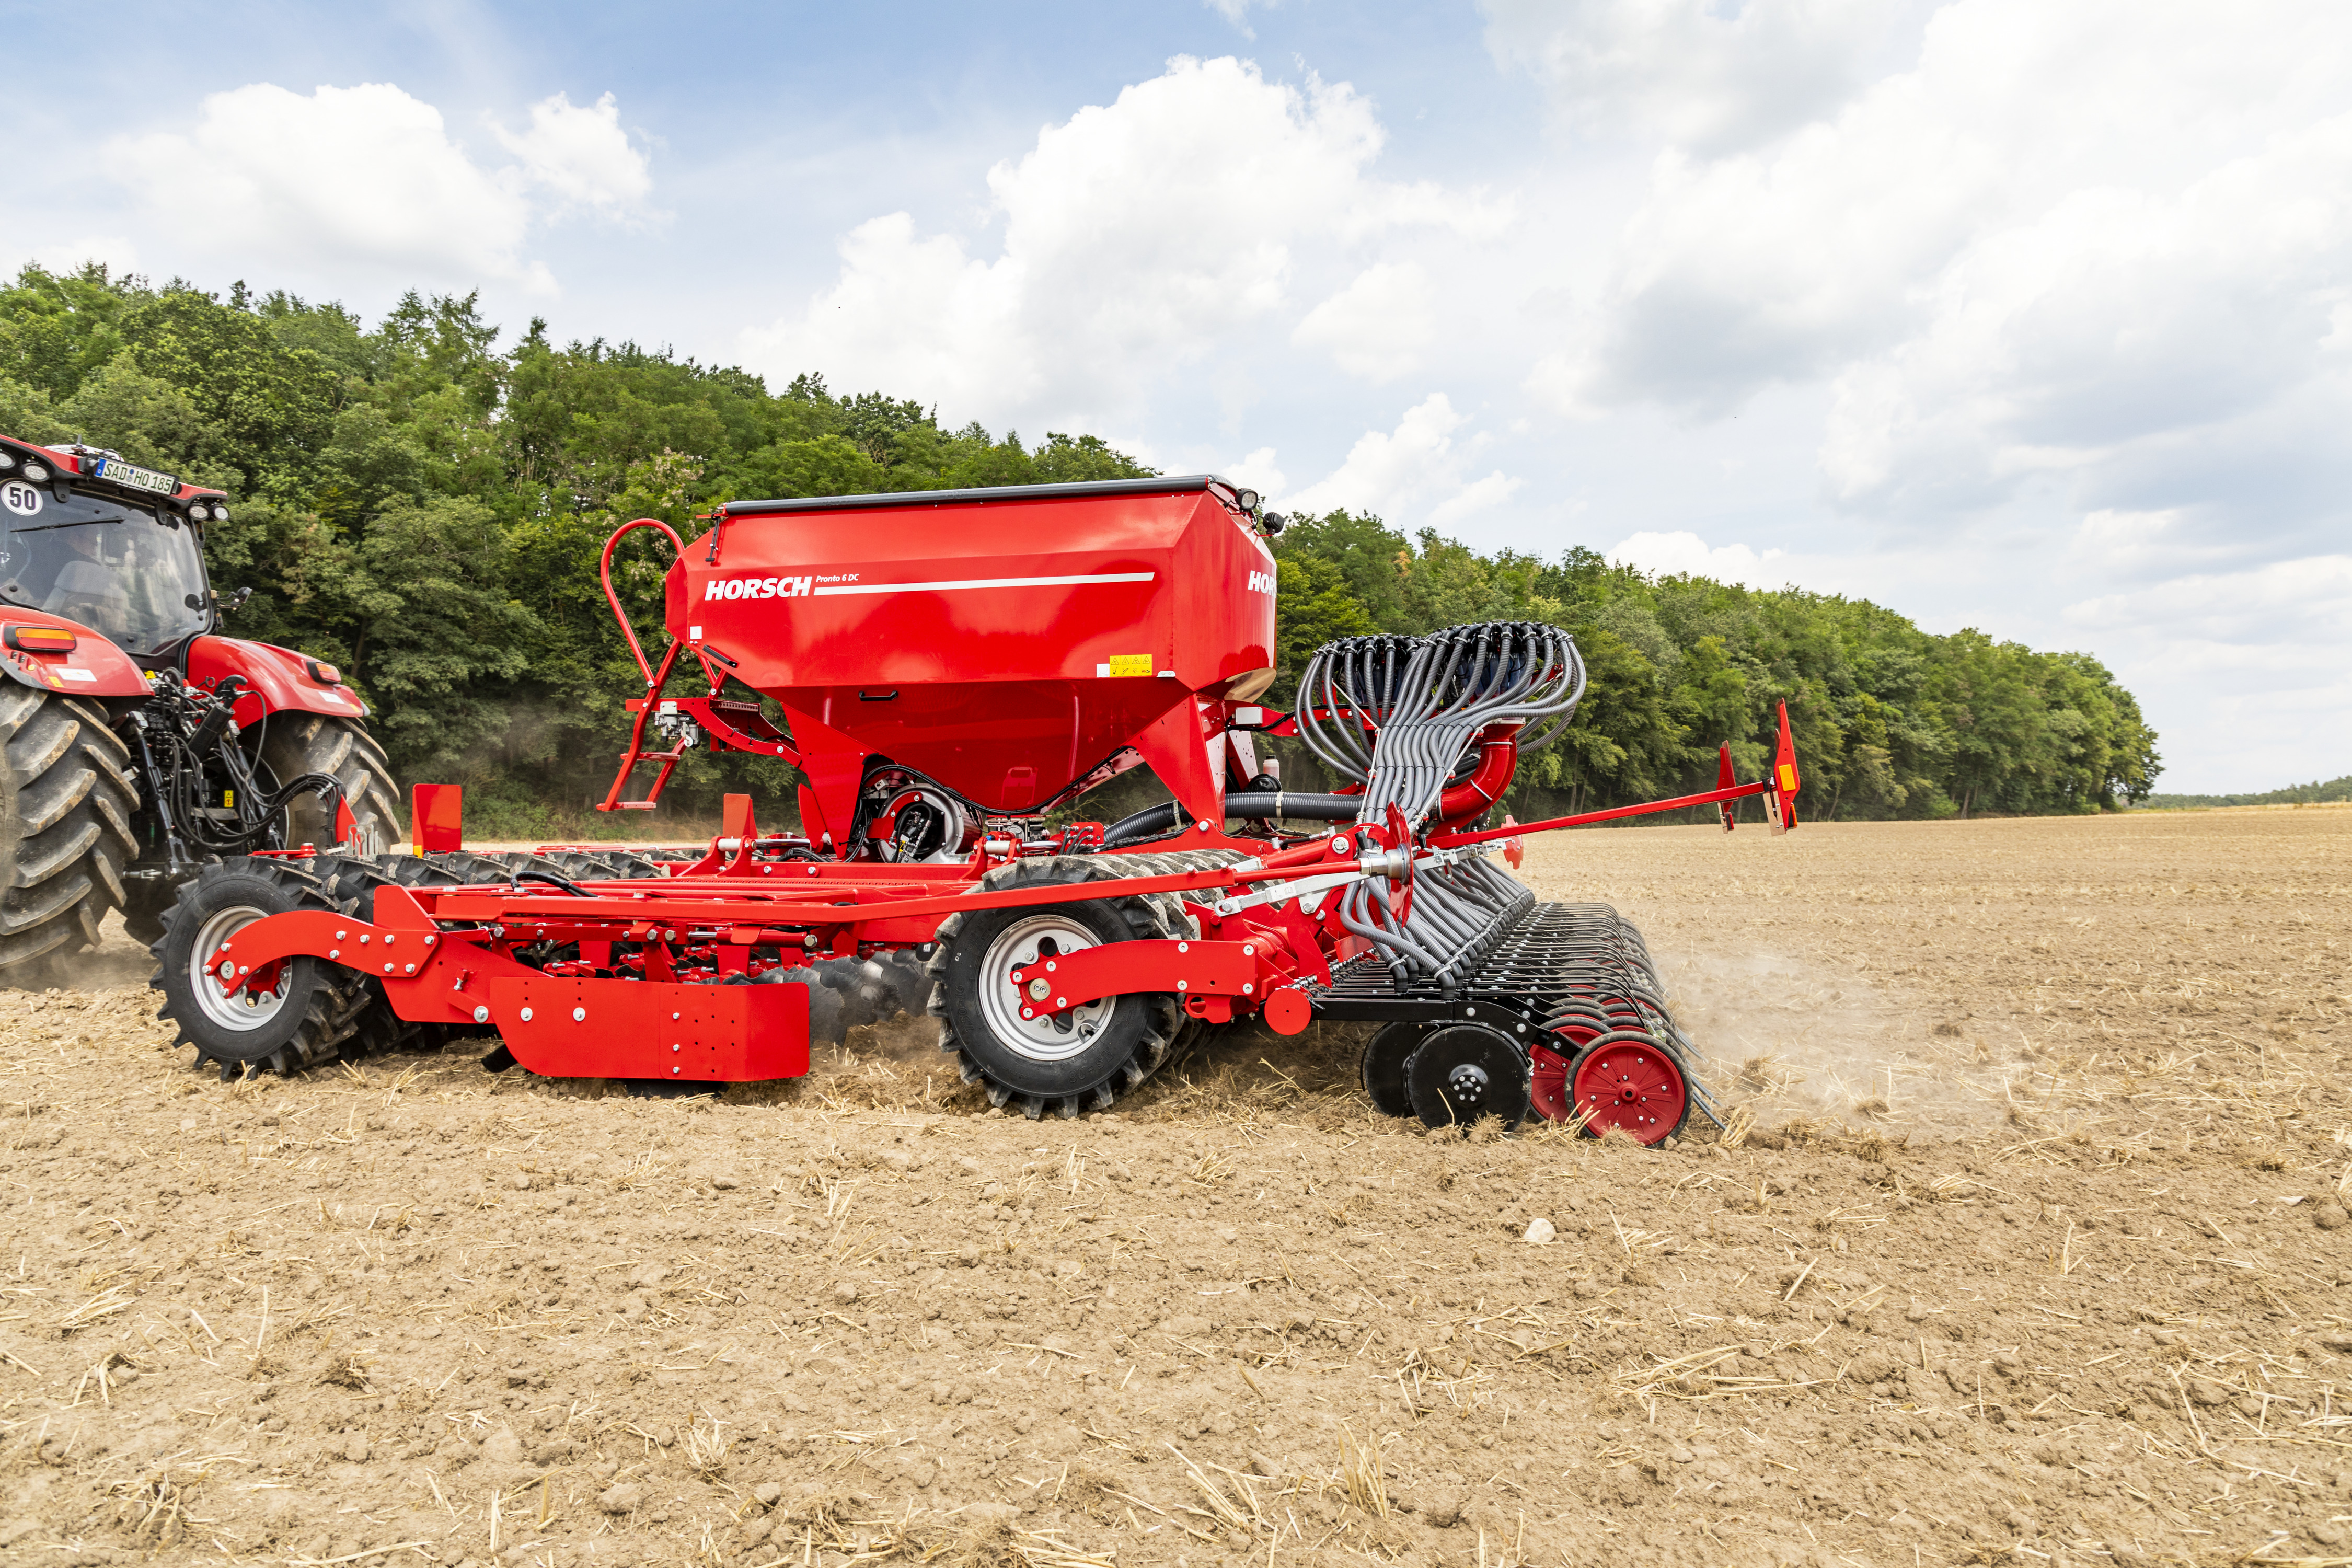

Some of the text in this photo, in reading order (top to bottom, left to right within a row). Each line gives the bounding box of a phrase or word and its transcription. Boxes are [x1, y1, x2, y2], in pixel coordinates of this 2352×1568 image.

[105, 463, 128, 480] SAD
[134, 471, 149, 486] HO
[151, 476, 172, 492] 185
[9, 486, 36, 510] 50
[705, 576, 812, 601] HORSCH
